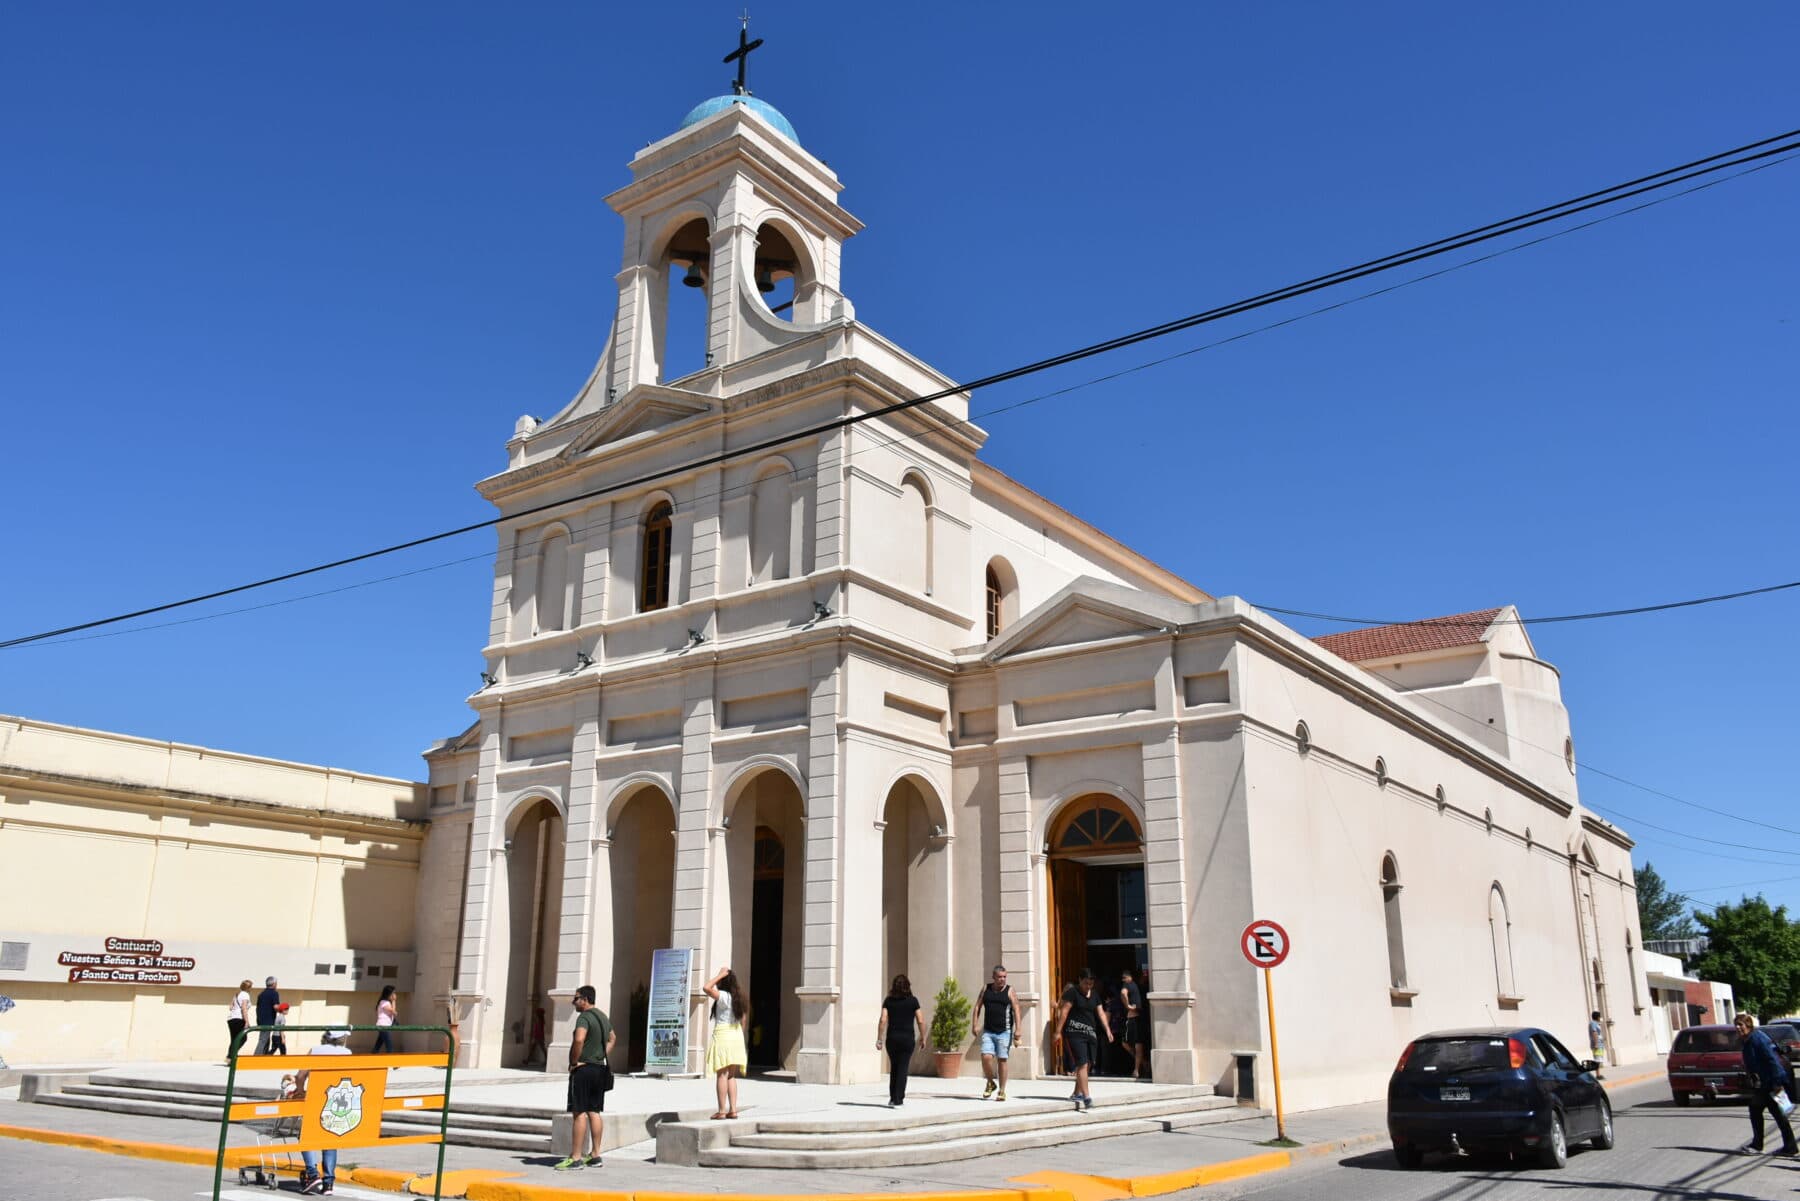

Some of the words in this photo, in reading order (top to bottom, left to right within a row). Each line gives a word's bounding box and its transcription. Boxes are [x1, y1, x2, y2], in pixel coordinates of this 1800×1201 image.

[108, 938, 161, 952] Santuario
[1255, 932, 1275, 957] E
[62, 953, 101, 964] Nuestra
[103, 955, 136, 966] Señora
[138, 957, 154, 967] Del
[156, 957, 193, 968] Tránsito
[73, 971, 80, 980] y
[81, 970, 109, 979] Santo
[111, 971, 135, 980] Cura
[137, 972, 178, 981] Brochero
